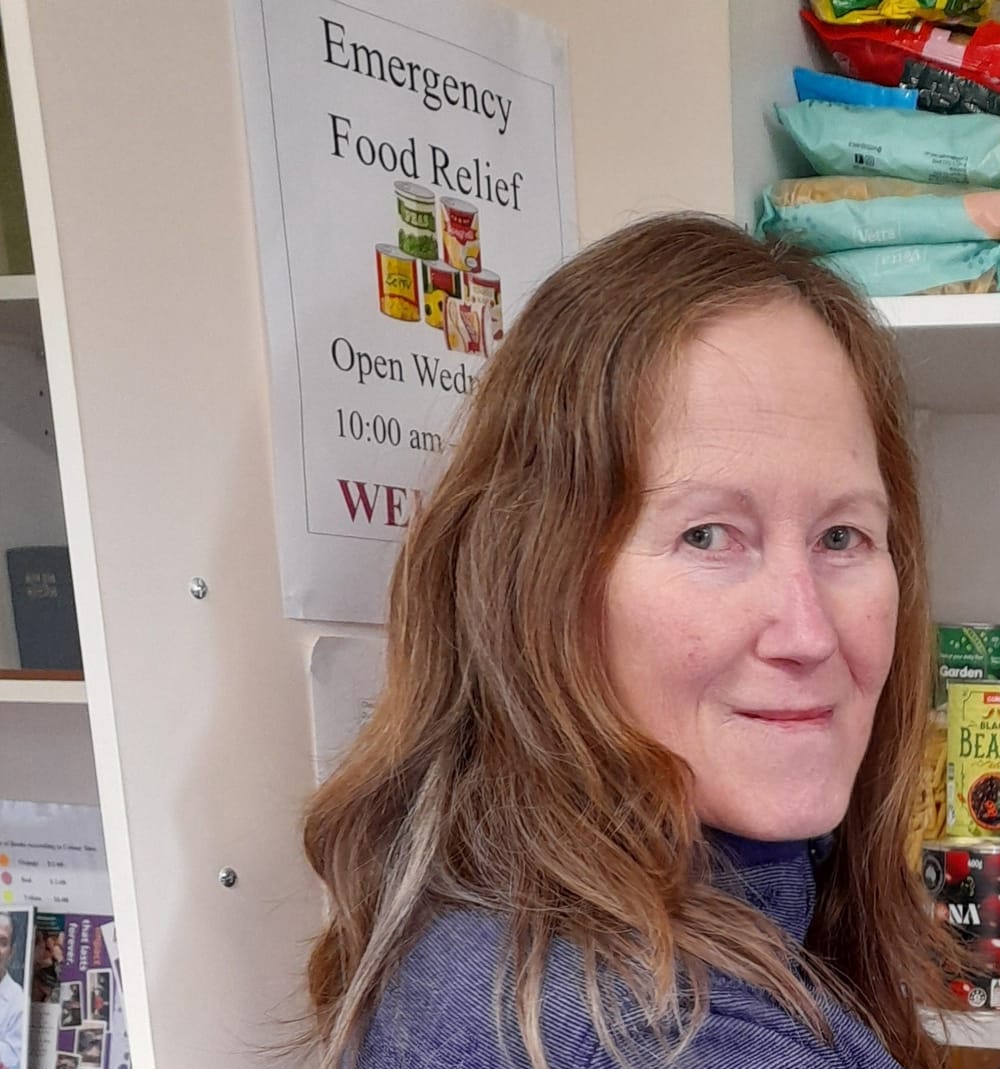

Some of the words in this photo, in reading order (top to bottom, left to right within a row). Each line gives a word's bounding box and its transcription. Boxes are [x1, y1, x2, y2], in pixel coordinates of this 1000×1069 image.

[318, 16, 513, 136] Emergency
[327, 113, 420, 180] Food
[428, 144, 524, 212] Relief
[331, 337, 406, 385] Open
[337, 408, 402, 447] 10:00
[409, 429, 444, 452] am
[940, 666, 983, 679] Garden
